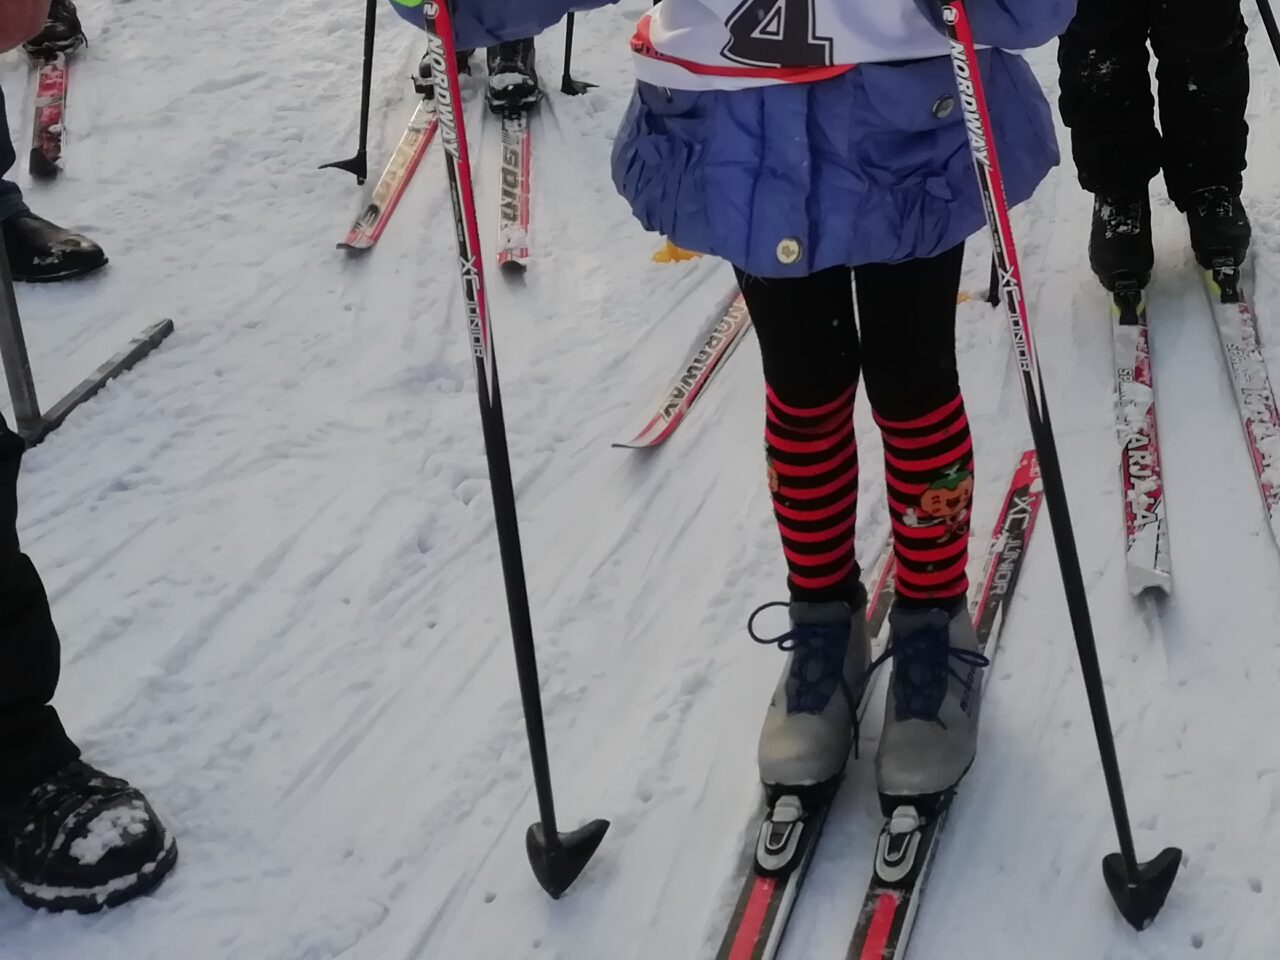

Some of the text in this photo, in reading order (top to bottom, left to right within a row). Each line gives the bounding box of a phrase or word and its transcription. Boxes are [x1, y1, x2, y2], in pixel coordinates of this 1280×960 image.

[428, 32, 463, 162] NORDWAY
[950, 40, 993, 172] NORDWAY
[460, 255, 480, 291] XC
[1000, 265, 1021, 302] XC
[662, 303, 746, 421] NORDWAY
[1005, 495, 1037, 531] XC
